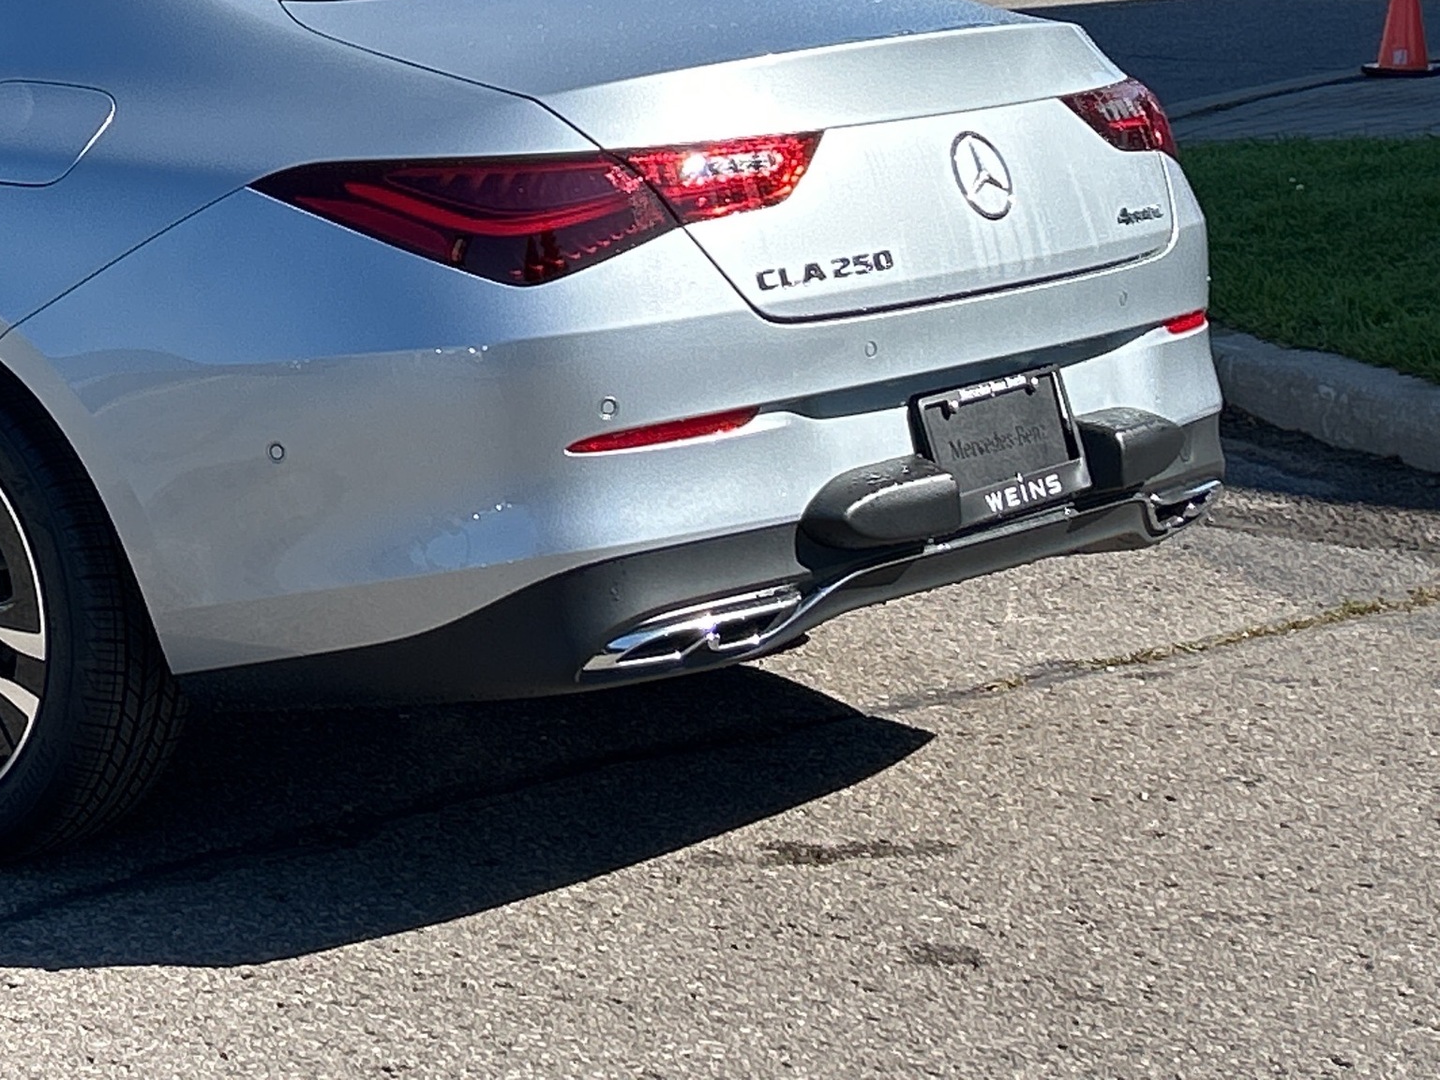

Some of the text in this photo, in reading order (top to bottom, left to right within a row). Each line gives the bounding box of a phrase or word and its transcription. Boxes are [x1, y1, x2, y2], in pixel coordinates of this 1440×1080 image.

[756, 249, 894, 291] CLA 250
[984, 473, 1062, 513] WEINS
